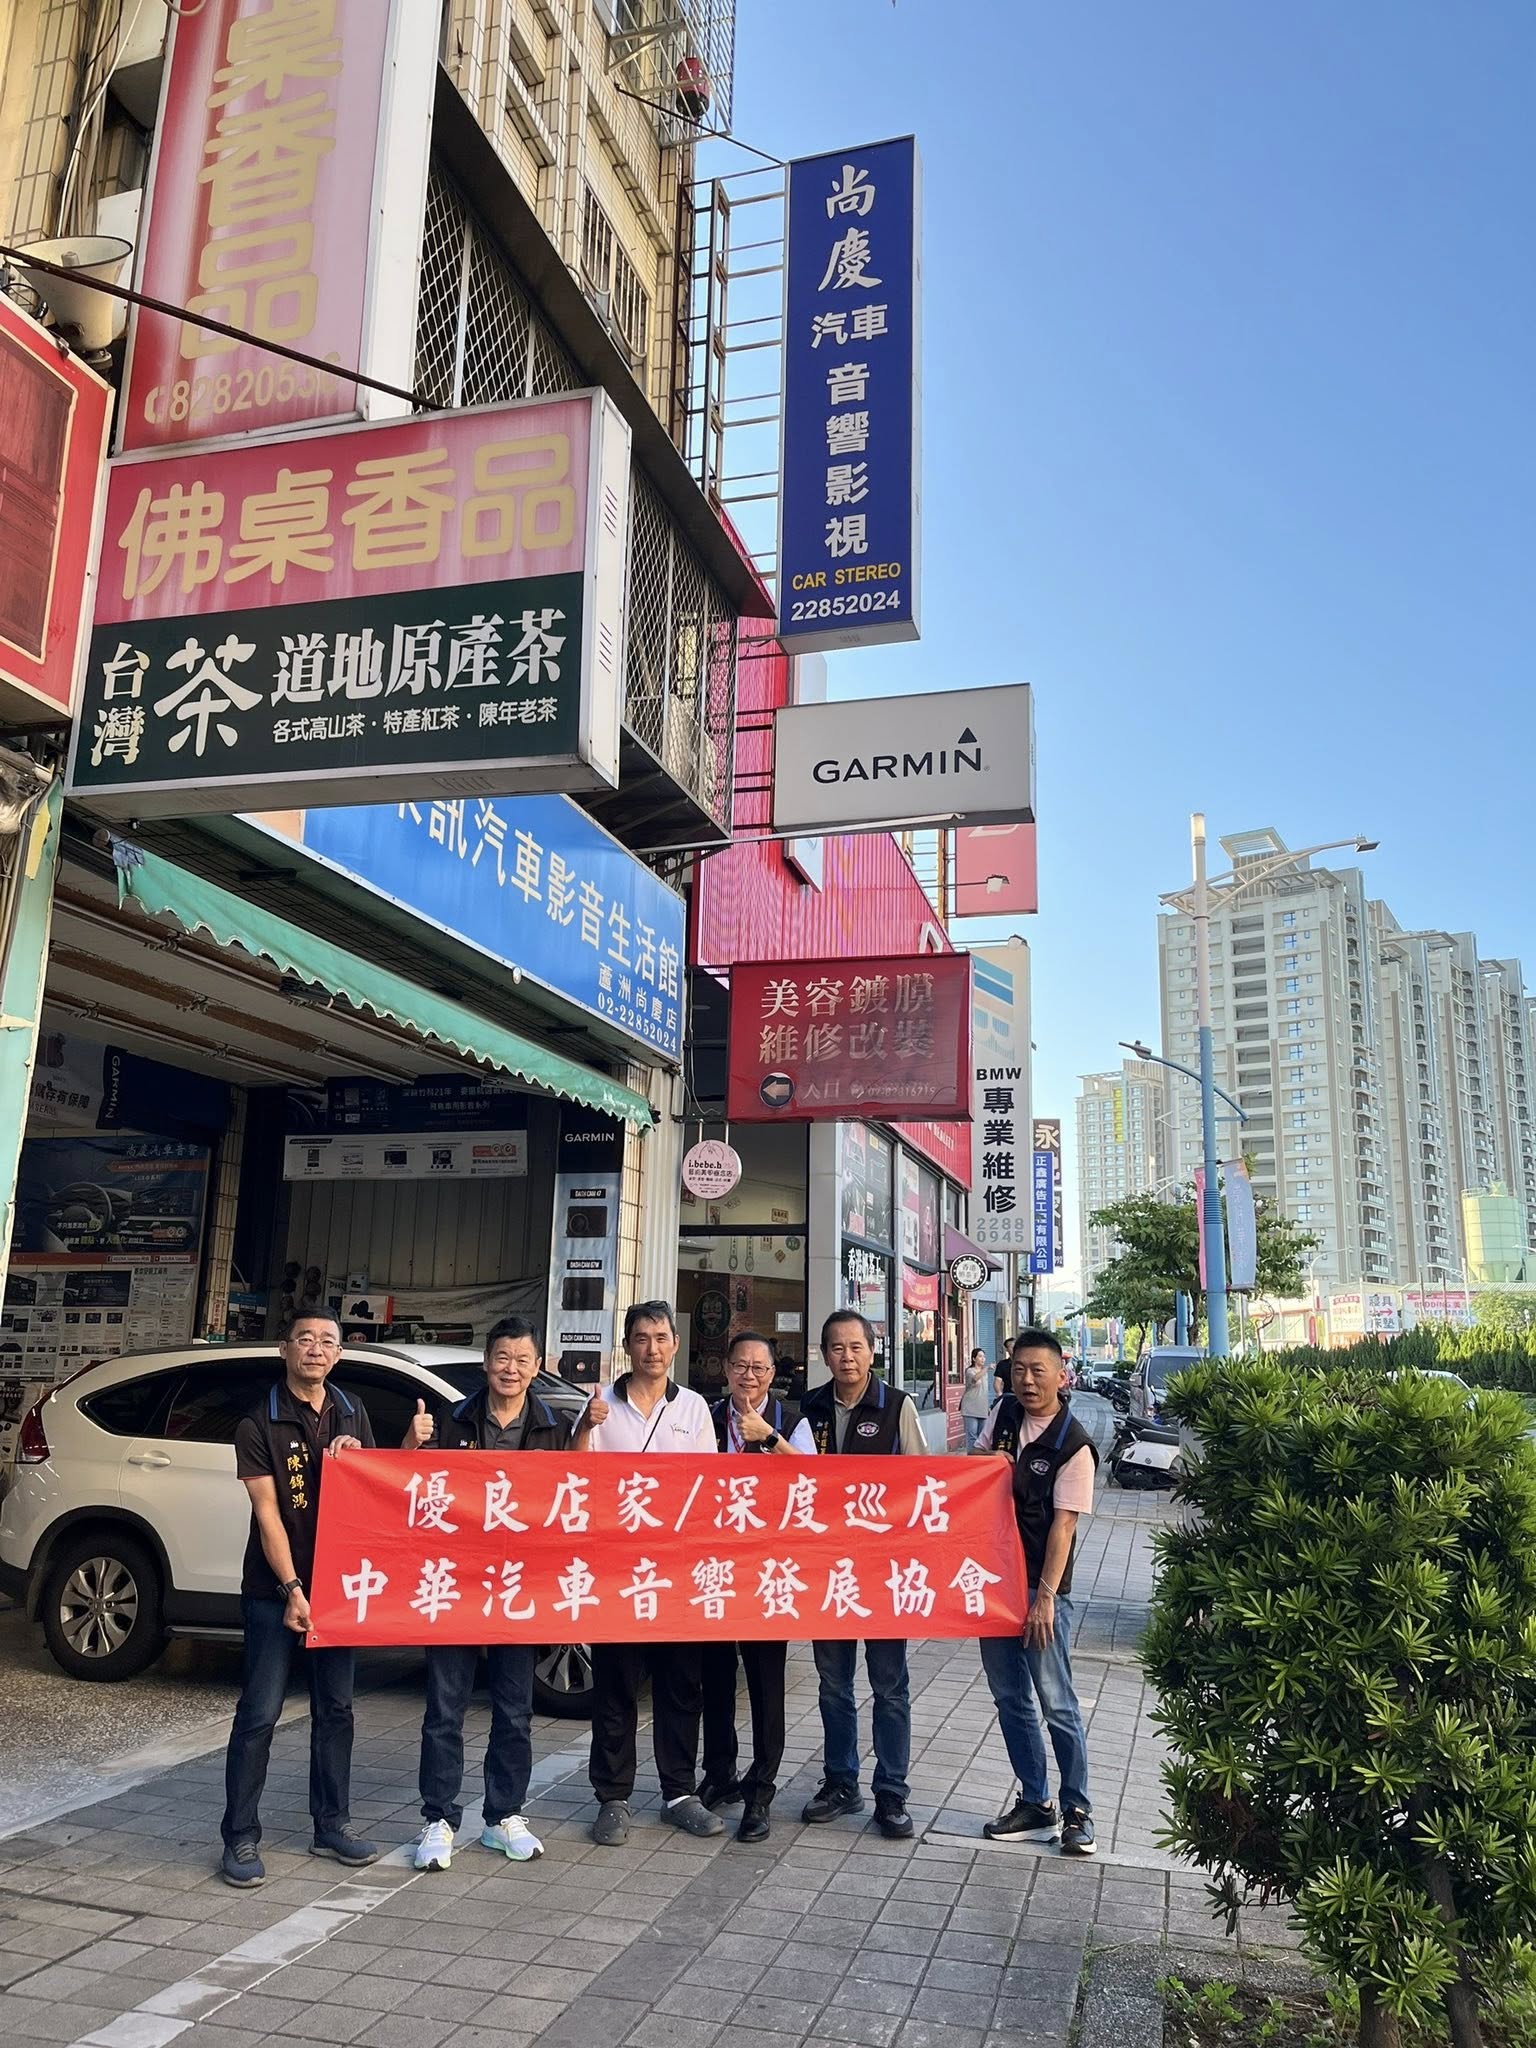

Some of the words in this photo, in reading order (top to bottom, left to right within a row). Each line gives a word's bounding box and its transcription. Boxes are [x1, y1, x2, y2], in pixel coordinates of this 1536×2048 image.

[118, 433, 576, 600] 佛桌香品
[791, 590, 901, 621] 22852024
[792, 568, 826, 590] CAR
[834, 562, 901, 585] STEREO
[271, 607, 567, 707] 道地原產茶
[91, 641, 146, 767] 台灣
[155, 634, 263, 757] 茶
[812, 748, 981, 784] GARMIN
[398, 797, 679, 1000] 訊汽車影音生活館
[597, 990, 678, 1052] 02-22852024
[598, 962, 678, 1032] 蘆洲尚慶店
[760, 973, 936, 1019] 美容鍍膜
[759, 1020, 936, 1065] 維修改裝
[105, 1055, 121, 1119] GARMIN
[804, 1081, 839, 1099] 入口
[976, 1067, 1022, 1081] BMW
[564, 1132, 615, 1144] GARMIN
[982, 1087, 1017, 1214] 專業維修
[976, 1218, 1024, 1231] 2288
[976, 1230, 1024, 1243] 0945
[403, 1472, 949, 1534] 優良店家/深度巡店
[340, 1556, 1002, 1624] 中華汽車音響發展協會
